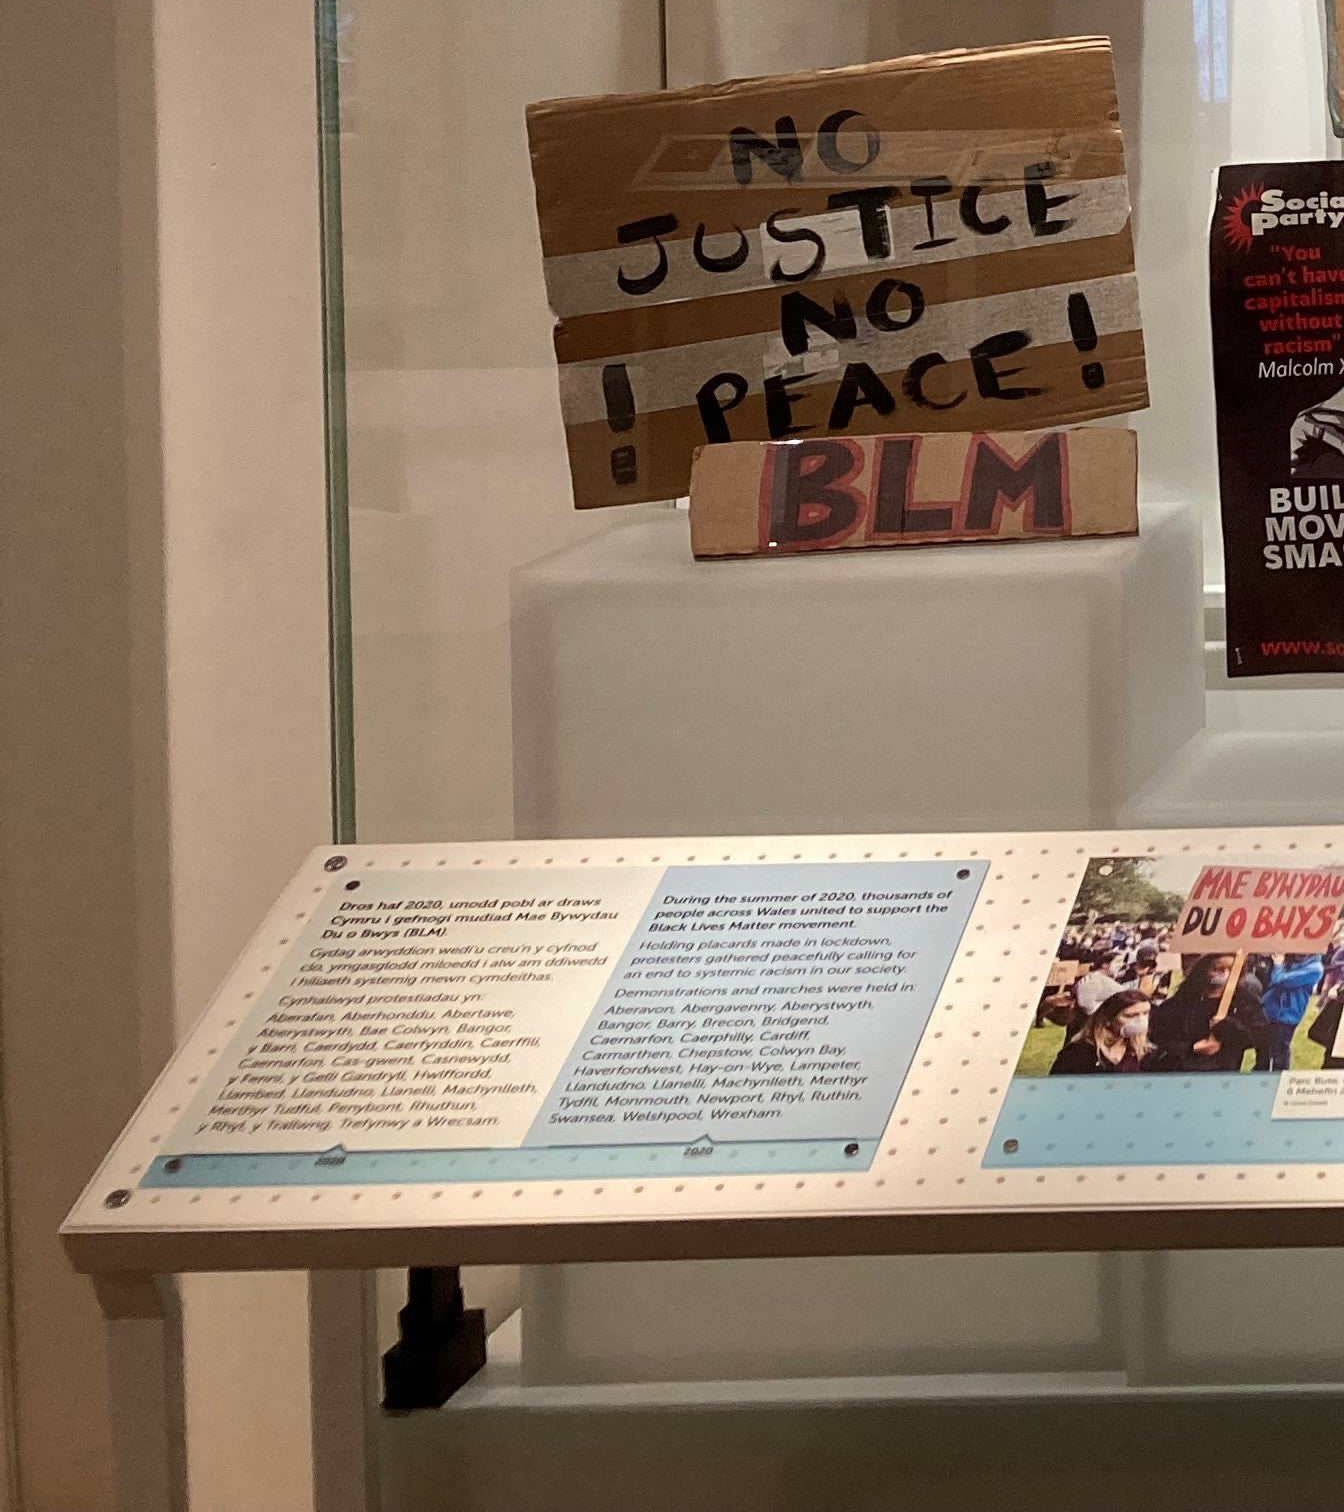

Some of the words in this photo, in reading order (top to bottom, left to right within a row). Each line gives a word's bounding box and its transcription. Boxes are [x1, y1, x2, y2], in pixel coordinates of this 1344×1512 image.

[728, 109, 880, 184] NO
[616, 160, 1080, 295] JUSTICE
[1244, 268, 1296, 288] can't
[780, 278, 925, 355] NO
[1258, 312, 1343, 333] without
[1258, 358, 1335, 379] Malcolm
[758, 430, 1073, 552] BLM
[1192, 868, 1252, 900] MAE
[339, 900, 373, 912] Dros
[378, 899, 403, 911] haf
[405, 898, 443, 911] 2020,
[449, 898, 498, 909] unodd
[500, 898, 535, 910] pobl
[538, 899, 553, 908] ar
[556, 897, 602, 907] draws
[663, 894, 711, 906] During
[714, 893, 737, 904] the
[740, 894, 798, 904] summer
[801, 892, 818, 902] of
[818, 891, 857, 904] 2020,
[861, 890, 934, 902] thousands
[936, 889, 954, 900] of
[330, 915, 381, 927] Cymru
[391, 913, 451, 927] gefnogi
[454, 911, 512, 923] mudiad
[514, 911, 546, 922] Mae
[551, 910, 618, 923] Bywydau
[653, 908, 705, 921] people
[707, 909, 752, 919] across
[756, 906, 798, 917] Wales
[800, 905, 847, 916] united
[849, 905, 864, 915] to
[866, 904, 922, 916] support
[925, 903, 949, 914] the
[1182, 905, 1223, 936] DU
[1225, 907, 1248, 938] O
[1251, 904, 1337, 940] BWYS
[322, 928, 343, 940] Du
[361, 928, 400, 941] Bwys
[648, 921, 687, 933] Black
[690, 921, 726, 932] Lives
[729, 920, 776, 931] Matter
[778, 919, 857, 930] movement.
[639, 940, 695, 952] Holding
[698, 939, 759, 953] placards
[760, 938, 801, 949] made
[803, 938, 818, 948] in
[820, 936, 892, 949] lockdown,
